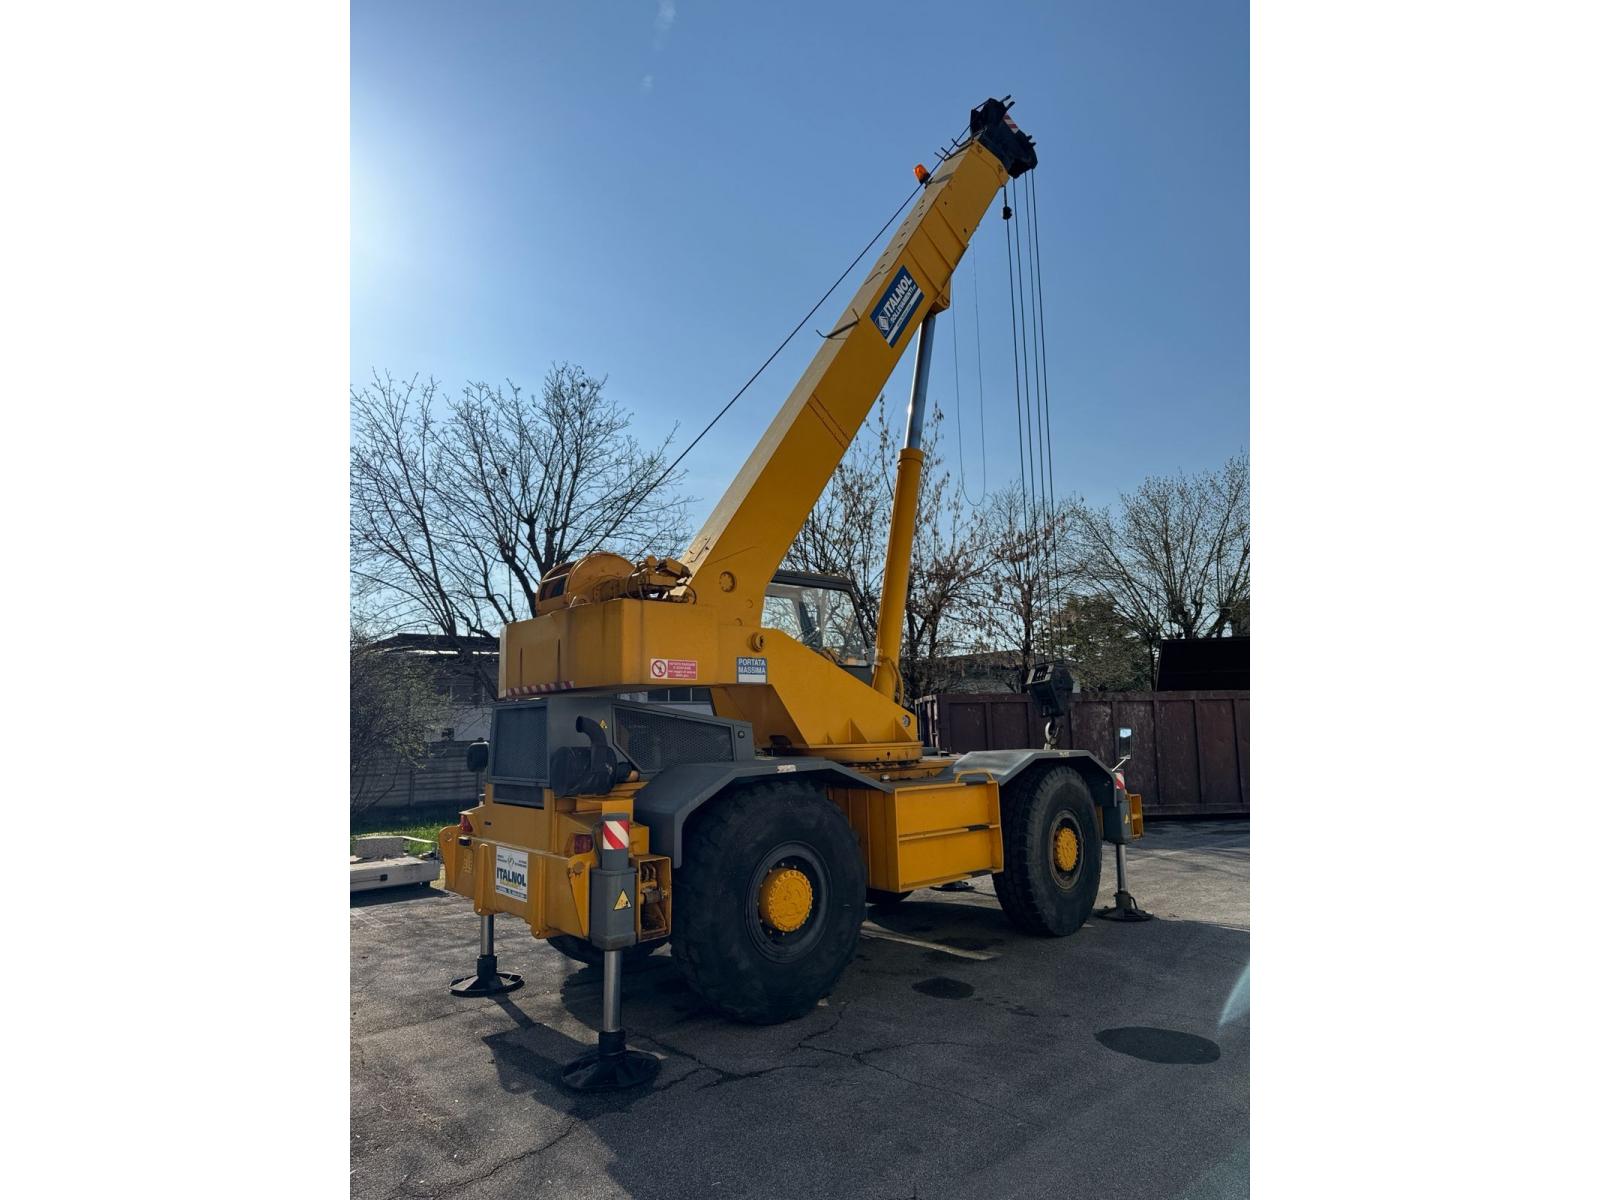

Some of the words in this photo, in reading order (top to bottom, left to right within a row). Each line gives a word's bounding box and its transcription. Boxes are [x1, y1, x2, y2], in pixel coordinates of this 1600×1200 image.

[883, 275, 913, 317] ITALNOL
[738, 658, 766, 666] PORTATA
[738, 666, 766, 674] MASSIMA
[496, 867, 527, 887] ITALNOL
